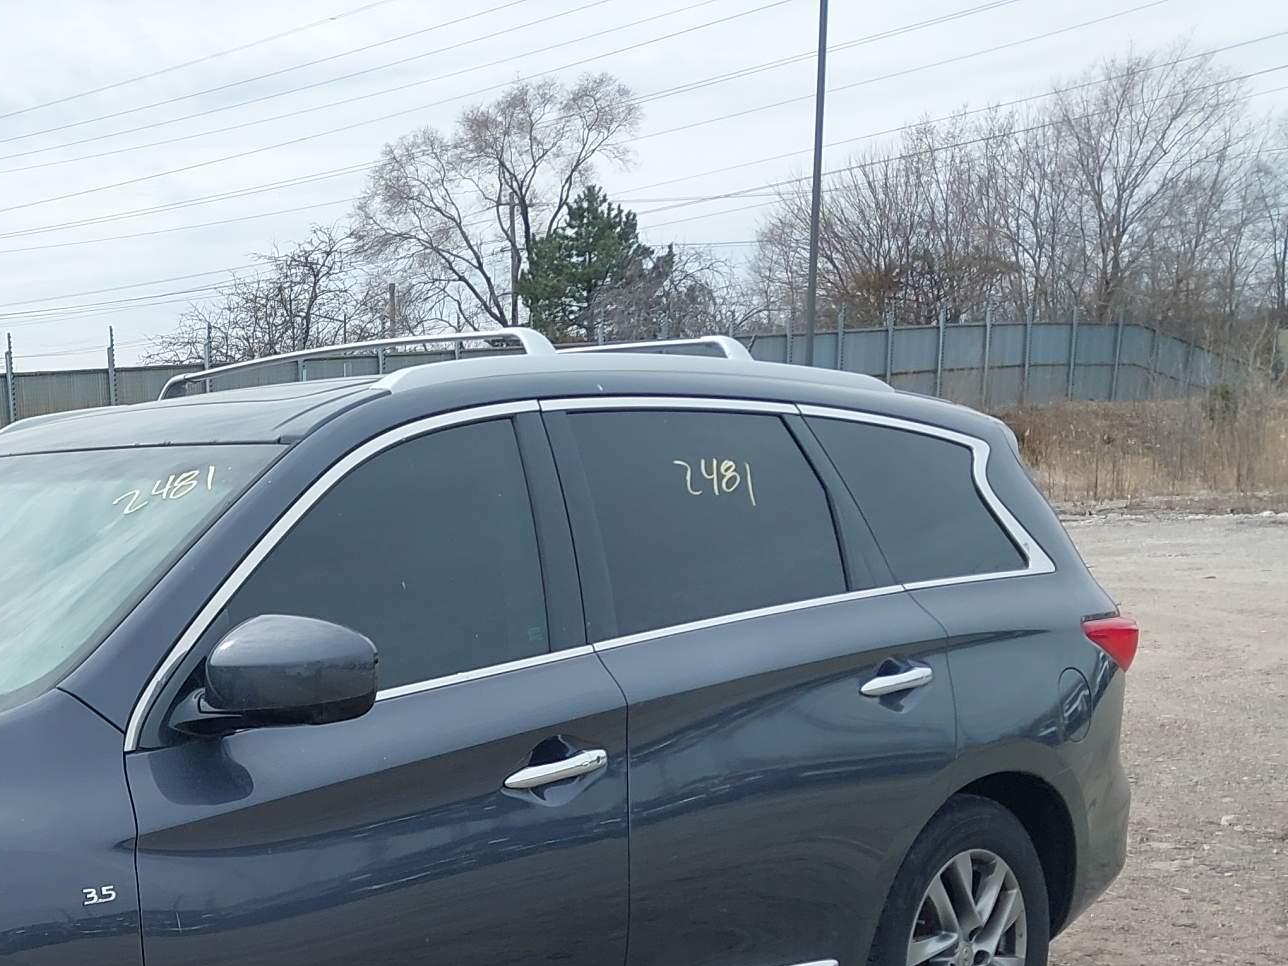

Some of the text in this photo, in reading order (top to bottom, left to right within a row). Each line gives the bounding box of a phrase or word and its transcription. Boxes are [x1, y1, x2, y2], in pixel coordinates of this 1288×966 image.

[112, 465, 215, 515] 2481
[672, 457, 757, 507] 2481
[82, 885, 117, 905] 3.5
